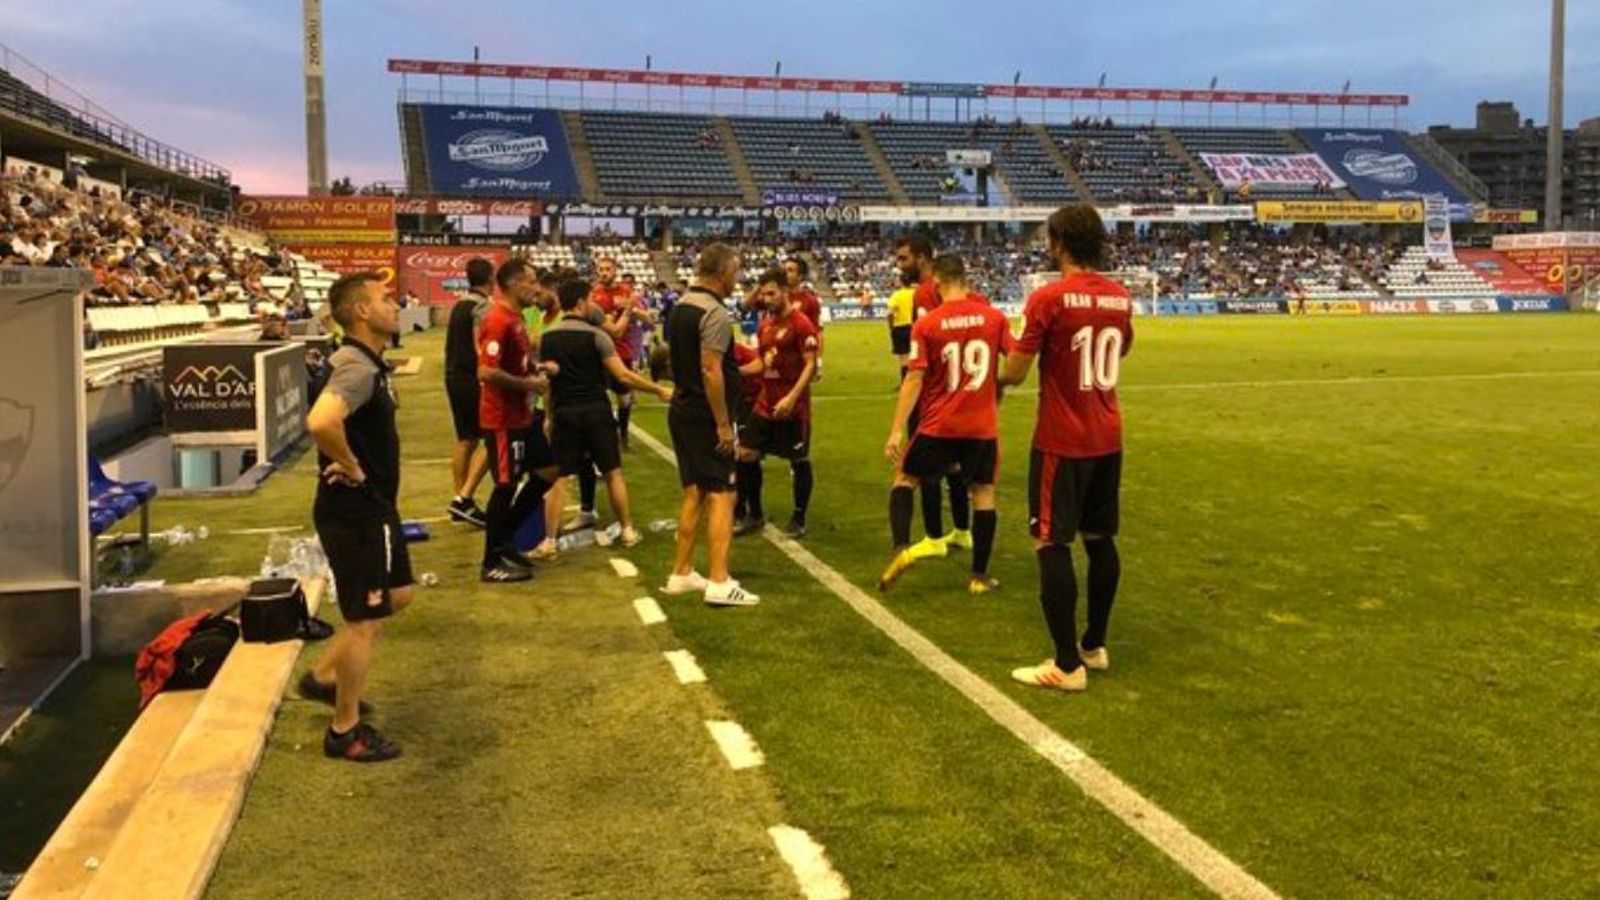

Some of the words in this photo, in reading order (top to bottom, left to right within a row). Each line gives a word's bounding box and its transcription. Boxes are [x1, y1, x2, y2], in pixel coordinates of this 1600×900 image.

[260, 201, 325, 214] RAMON
[332, 201, 390, 215] SOLER
[942, 340, 991, 392] 19
[1071, 326, 1123, 391] 10
[169, 382, 211, 397] VAL
